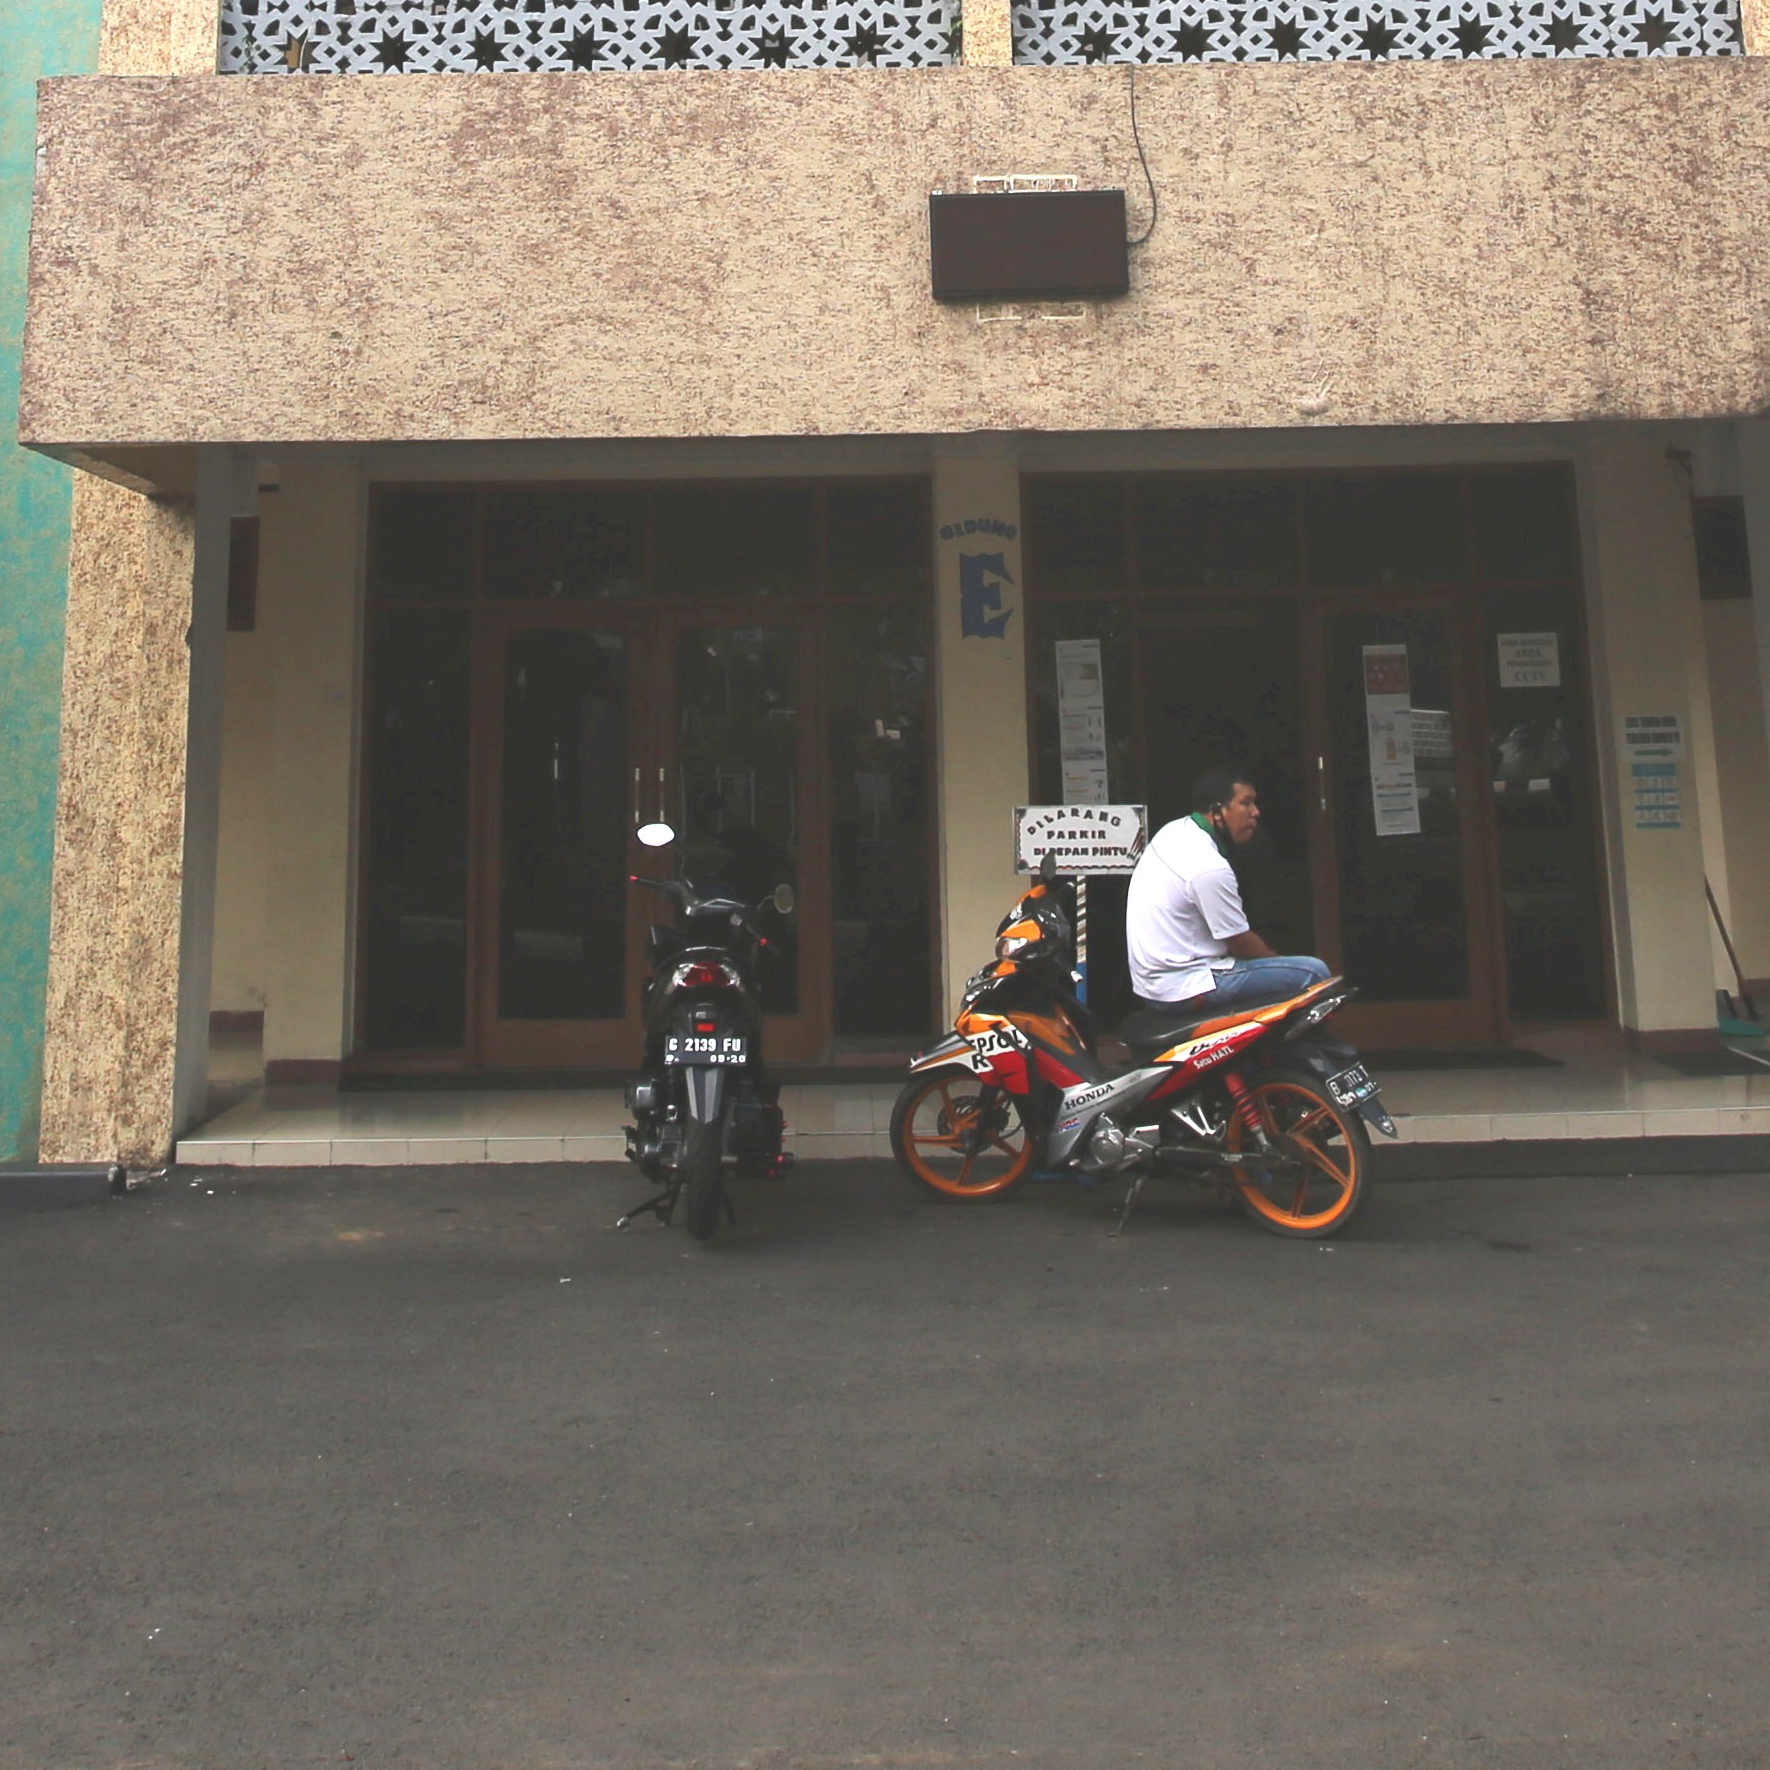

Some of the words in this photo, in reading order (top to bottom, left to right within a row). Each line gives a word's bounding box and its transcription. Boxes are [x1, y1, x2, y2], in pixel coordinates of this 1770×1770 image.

[960, 551, 1014, 640] E
[1027, 808, 1121, 835] DILARANG
[1047, 830, 1106, 840] PARKIR
[1034, 848, 1046, 856] DI
[1092, 847, 1127, 857] PINTU
[685, 1038, 717, 1052] 2139
[723, 1038, 741, 1052] FU
[1065, 1084, 1116, 1110] HONDA
